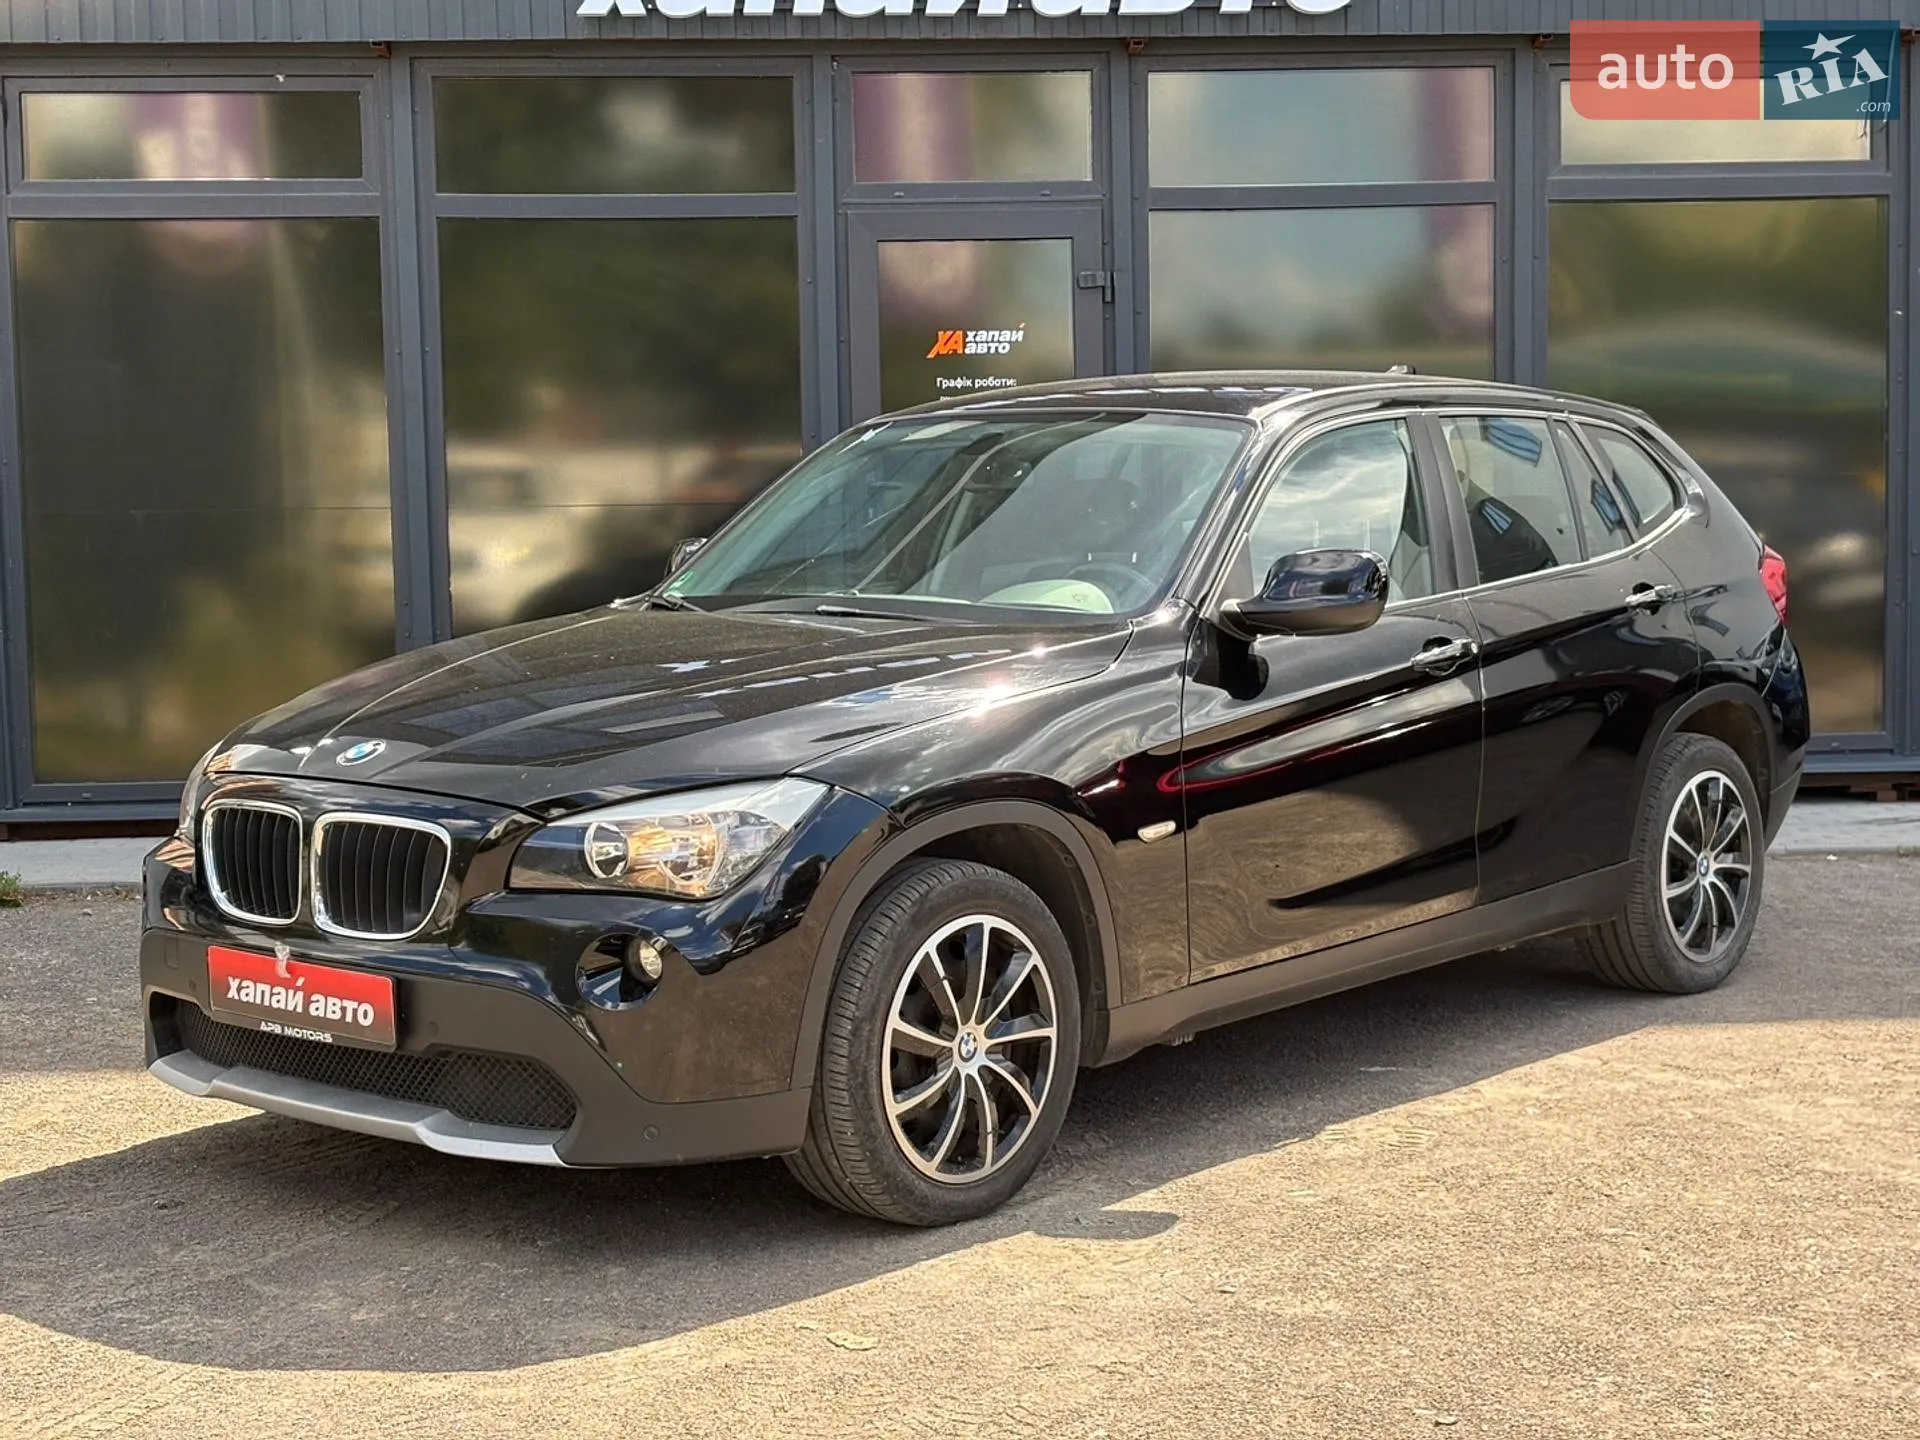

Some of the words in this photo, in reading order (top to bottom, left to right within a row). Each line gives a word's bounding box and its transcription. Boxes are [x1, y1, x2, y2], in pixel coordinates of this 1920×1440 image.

[965, 322, 1026, 343] хапай
[964, 342, 1011, 355] авто
[936, 376, 973, 389] Графік
[974, 376, 1017, 388] роботи:
[226, 976, 306, 1013] хапай
[309, 992, 375, 1027] авто
[284, 1026, 333, 1043] MOTORS
